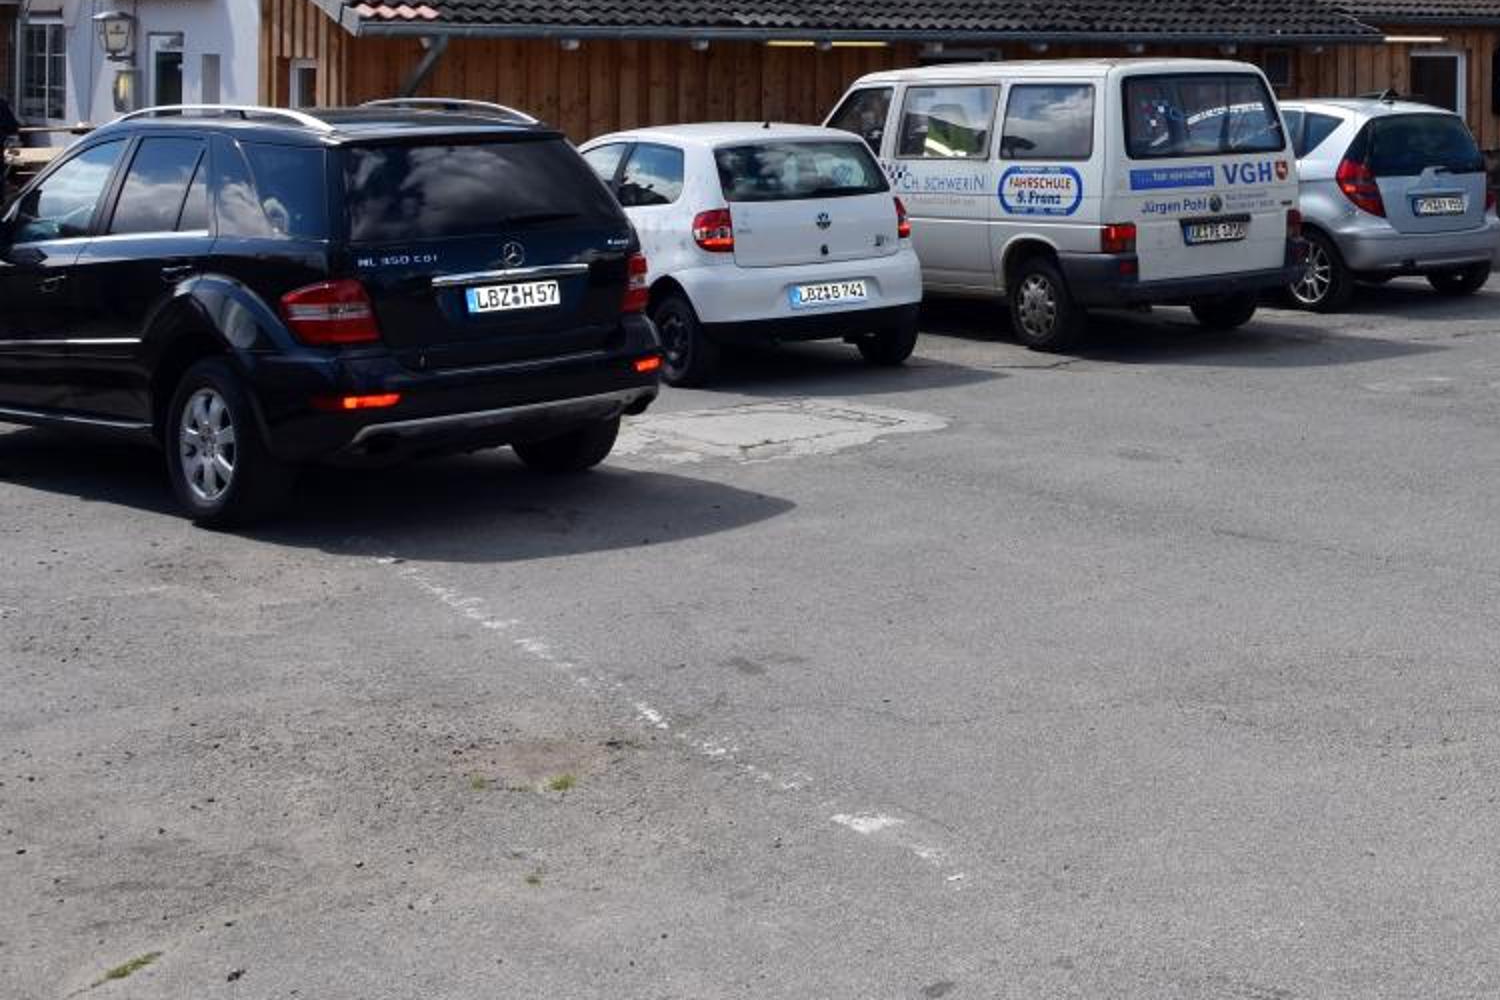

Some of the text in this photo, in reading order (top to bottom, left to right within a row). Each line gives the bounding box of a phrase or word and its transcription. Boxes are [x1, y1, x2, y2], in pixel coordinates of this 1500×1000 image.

[1221, 161, 1272, 184] VGH
[1009, 176, 1072, 190] FAHRSCHULE
[1141, 200, 1180, 214] Jürgen
